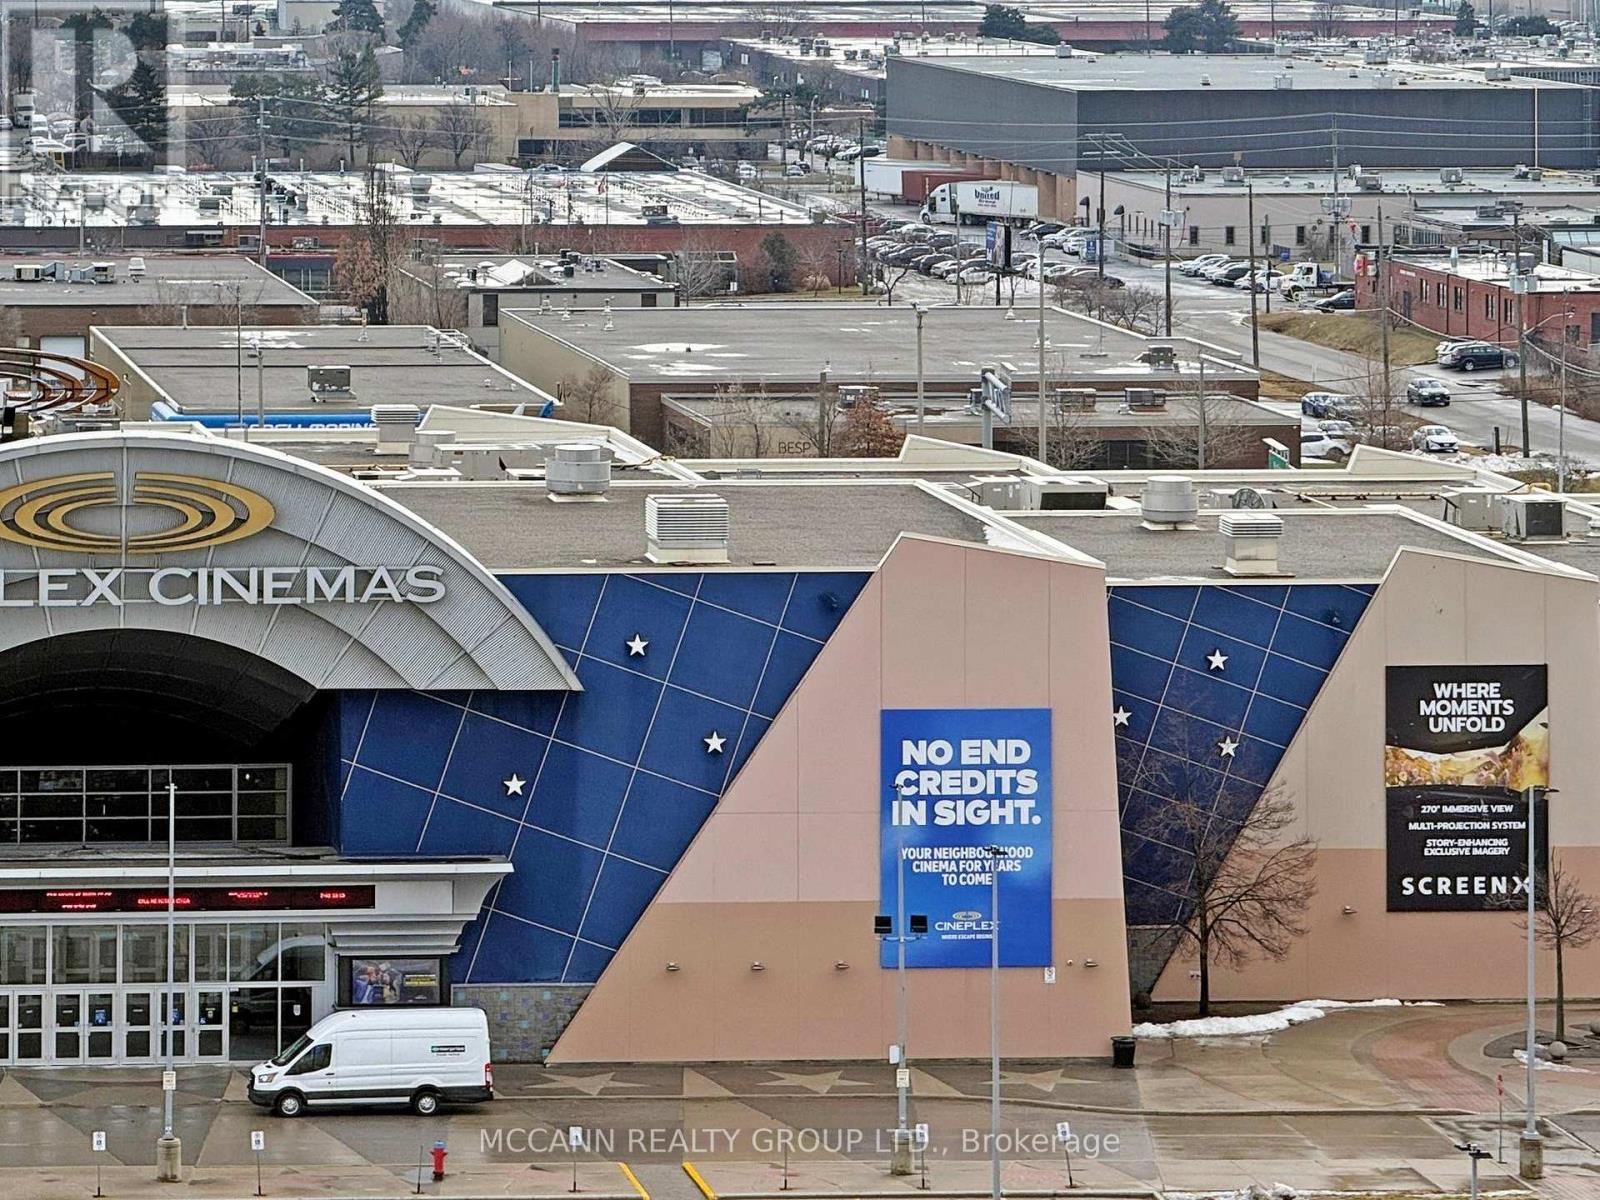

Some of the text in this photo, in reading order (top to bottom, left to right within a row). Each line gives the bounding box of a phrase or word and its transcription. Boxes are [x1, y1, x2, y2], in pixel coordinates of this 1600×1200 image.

[778, 441, 811, 454] BESP
[148, 565, 447, 607] CINEMAS
[1433, 682, 1501, 699] WHERE
[1419, 699, 1515, 716] MOMENTS
[1428, 716, 1505, 733] UNFOLD
[902, 739, 1031, 766] NO END
[894, 769, 1039, 796] CREDITS
[892, 799, 1042, 826] IN SIGHT.
[1442, 804, 1489, 813] IMMERSIVE
[1490, 804, 1514, 813] VIEW
[1408, 821, 1526, 831] MULTI-PROJECTION SYSTEM
[1426, 838, 1509, 848] STORY-ENHANCING
[901, 847, 932, 860] YOUR
[1423, 846, 1510, 856] EXCLUSIVE IMAGERY
[912, 860, 957, 872] CINEMA
[959, 860, 982, 872] FOR
[941, 873, 993, 885] TO COME
[1402, 876, 1531, 896] SCREENX
